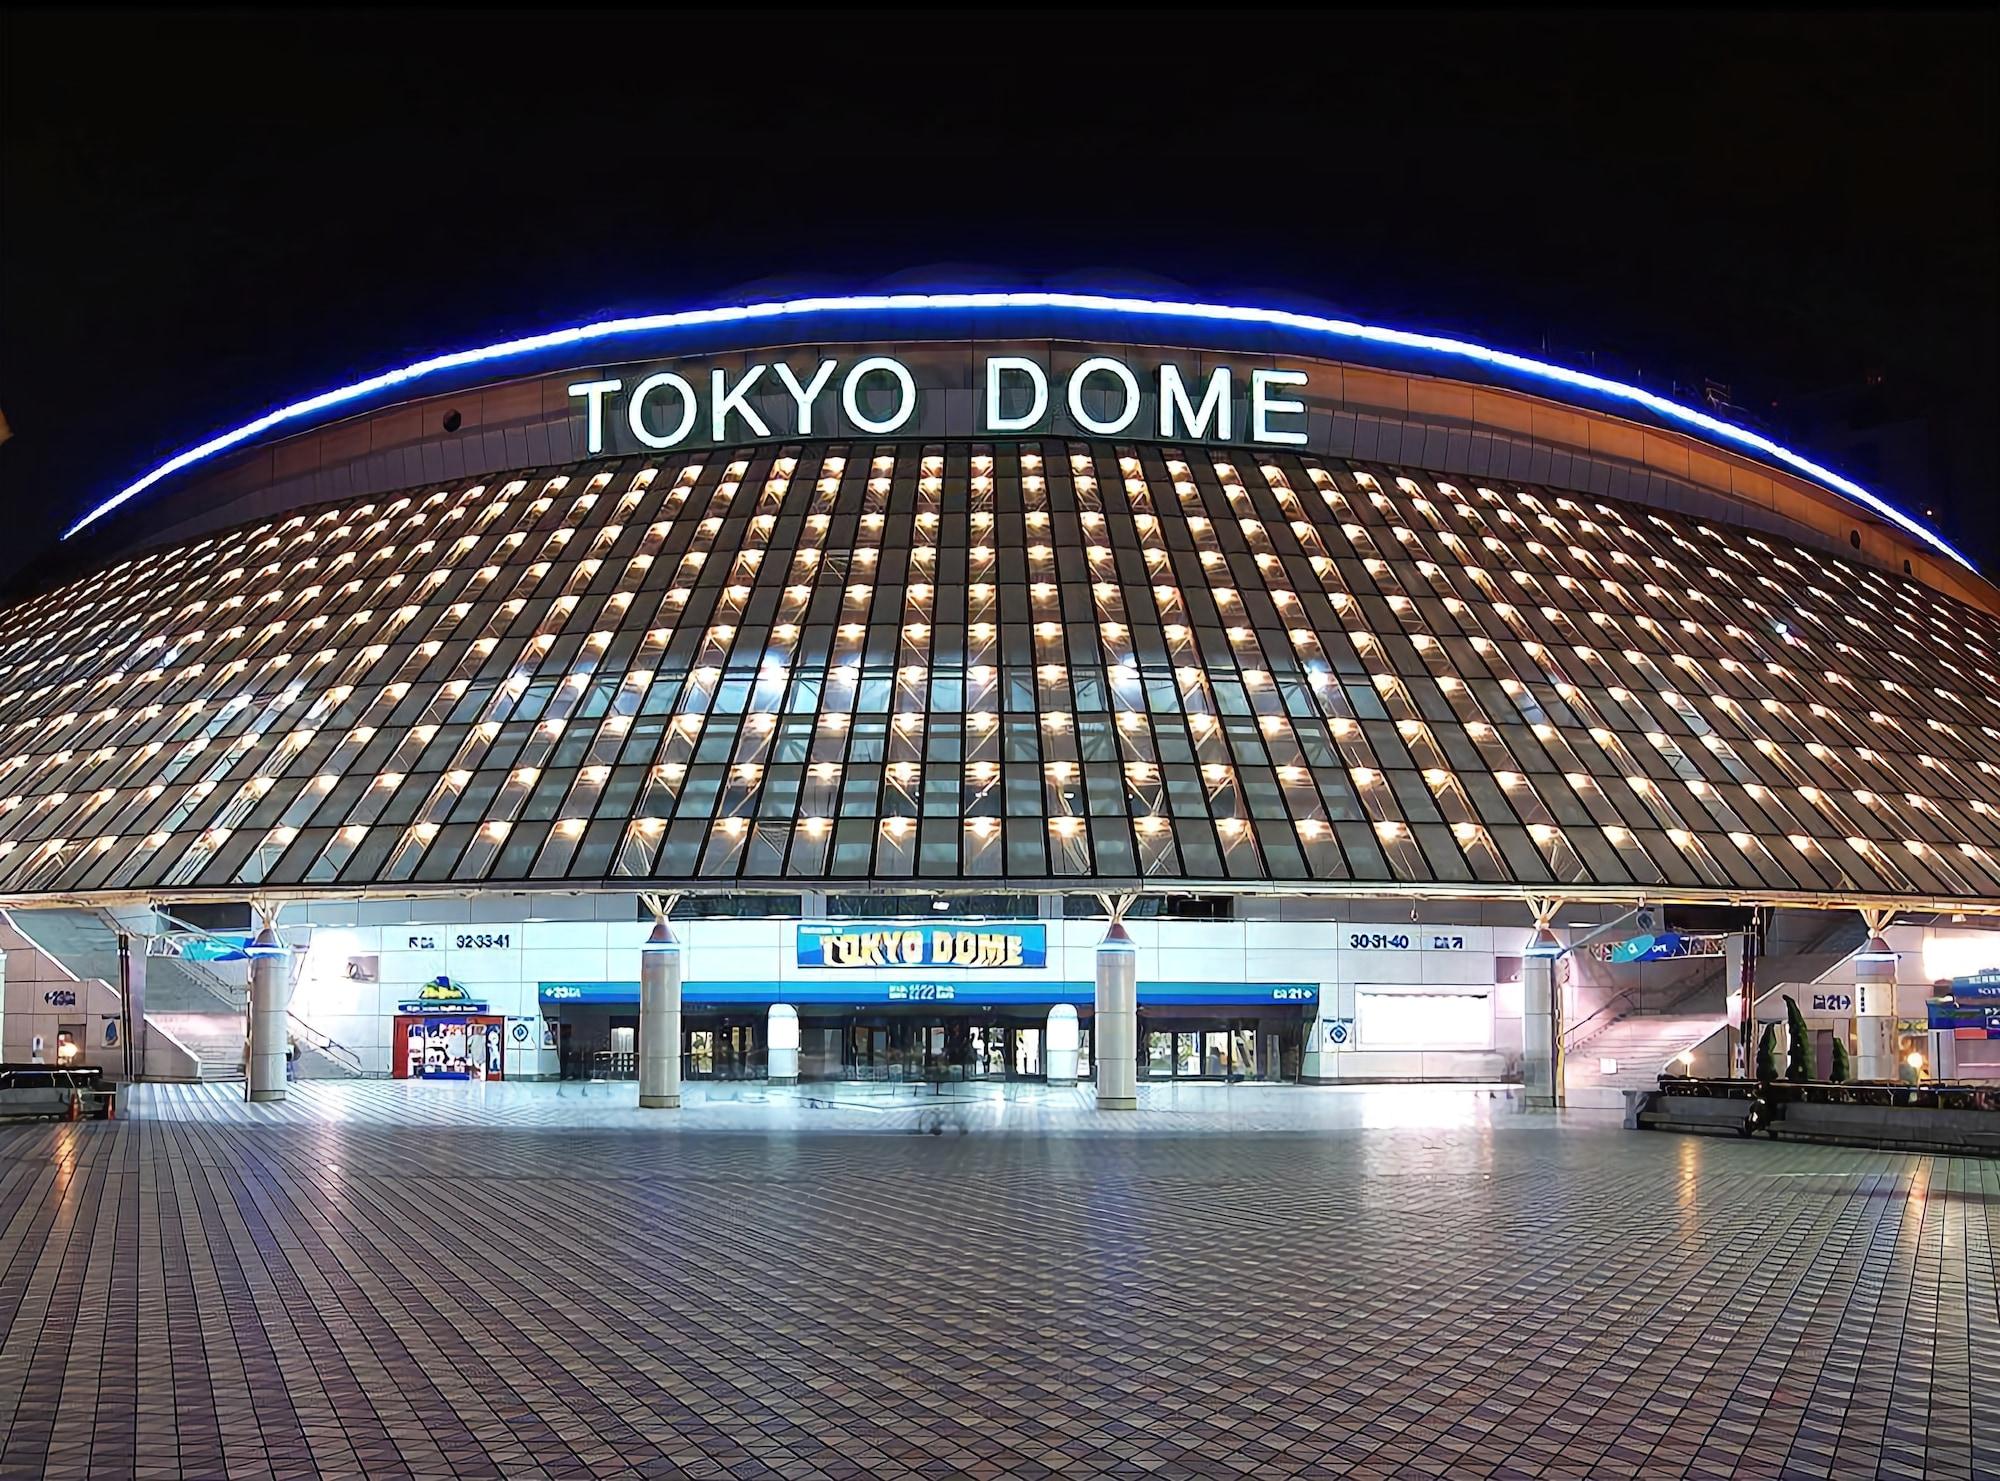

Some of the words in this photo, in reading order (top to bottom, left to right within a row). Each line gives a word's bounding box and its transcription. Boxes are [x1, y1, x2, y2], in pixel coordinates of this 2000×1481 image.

[568, 357, 917, 454] TOKYO
[985, 357, 1309, 445] DOME
[820, 930, 924, 967] TOKYO
[932, 930, 1024, 966] DOME
